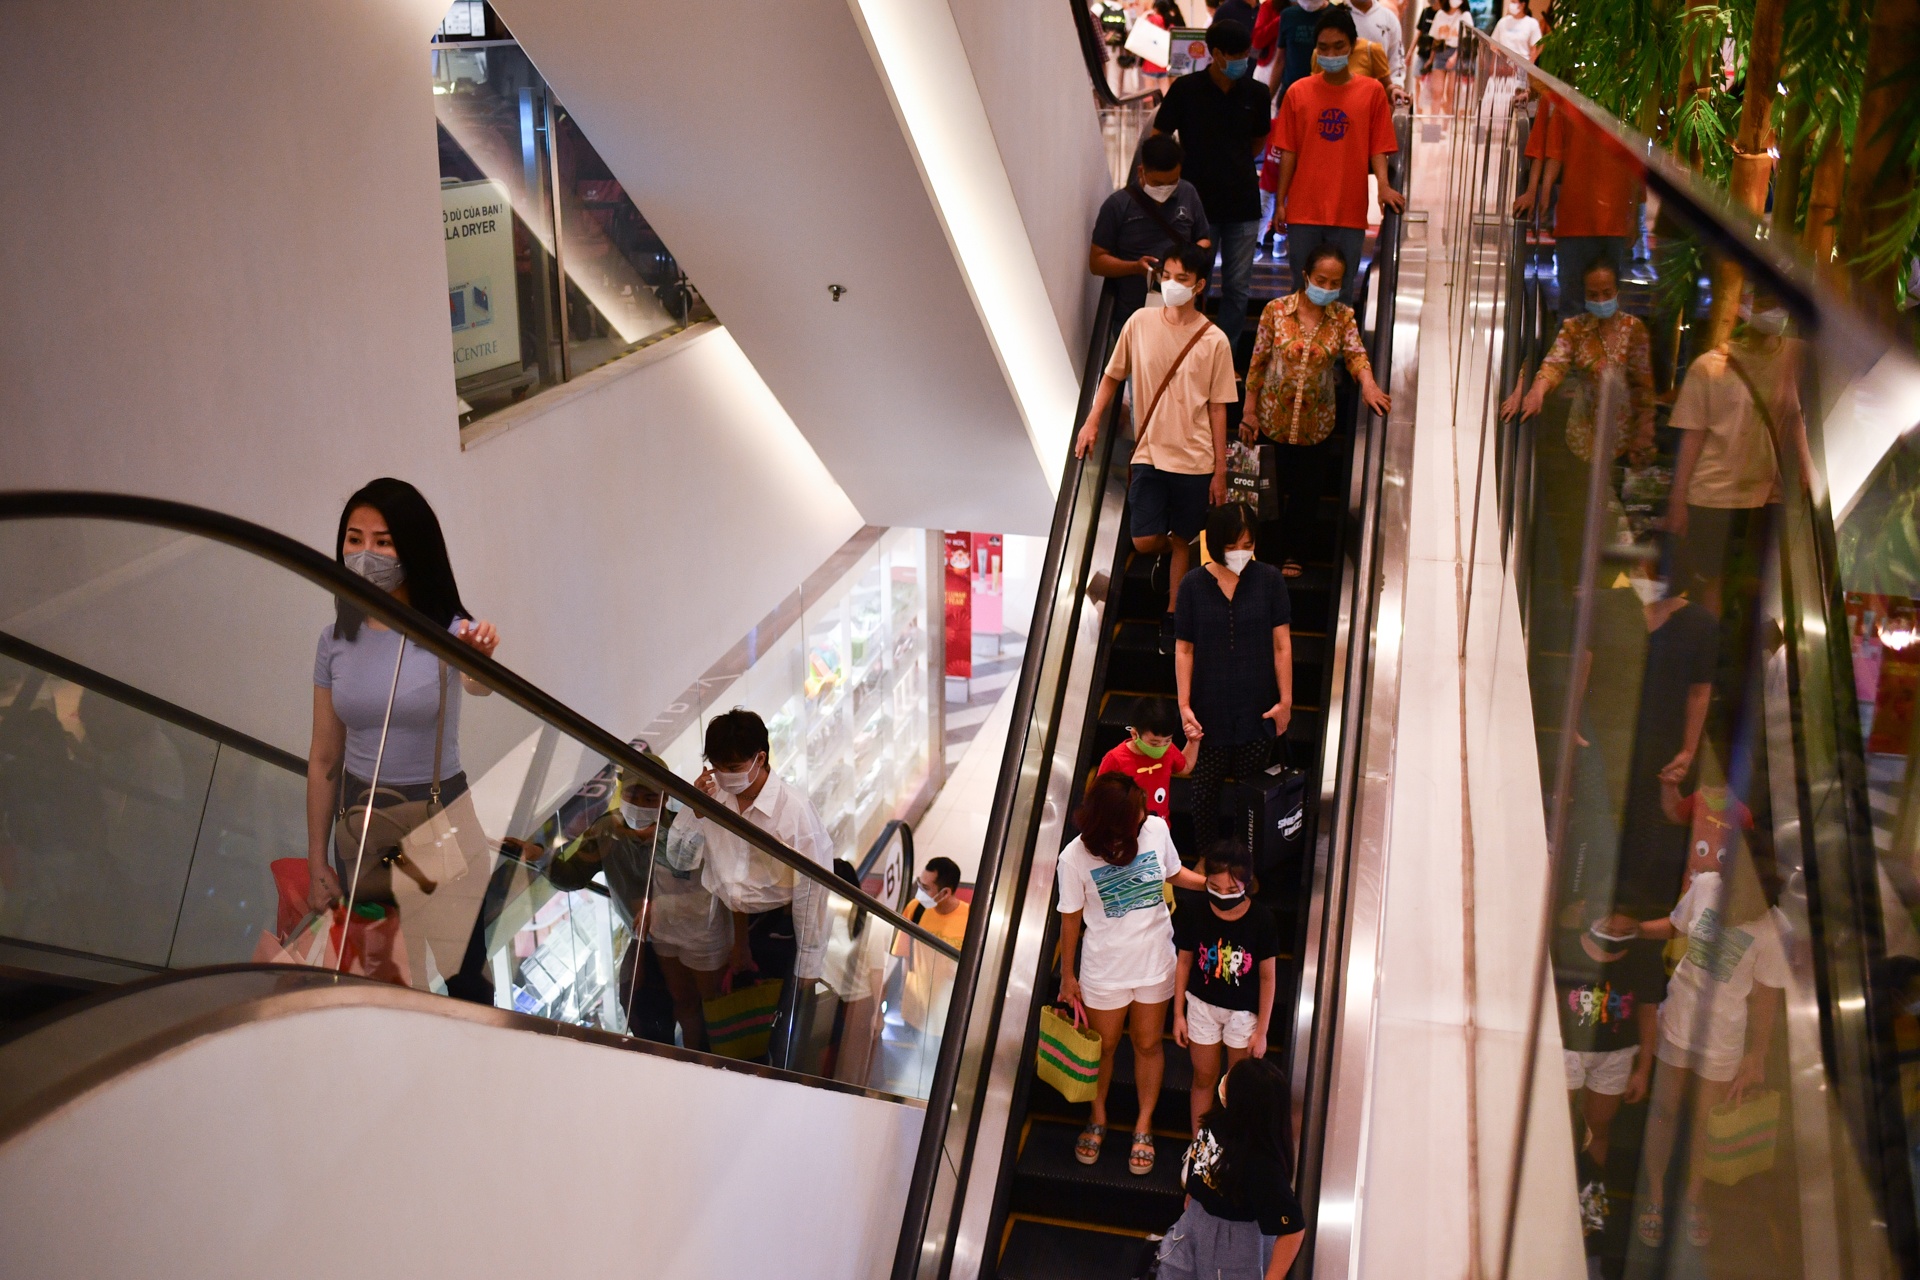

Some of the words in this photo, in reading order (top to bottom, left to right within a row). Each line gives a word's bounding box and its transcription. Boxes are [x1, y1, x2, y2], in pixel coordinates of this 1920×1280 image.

[462, 220, 496, 237] DRYER
[1233, 477, 1255, 487] crocs
[886, 852, 901, 899] B1
